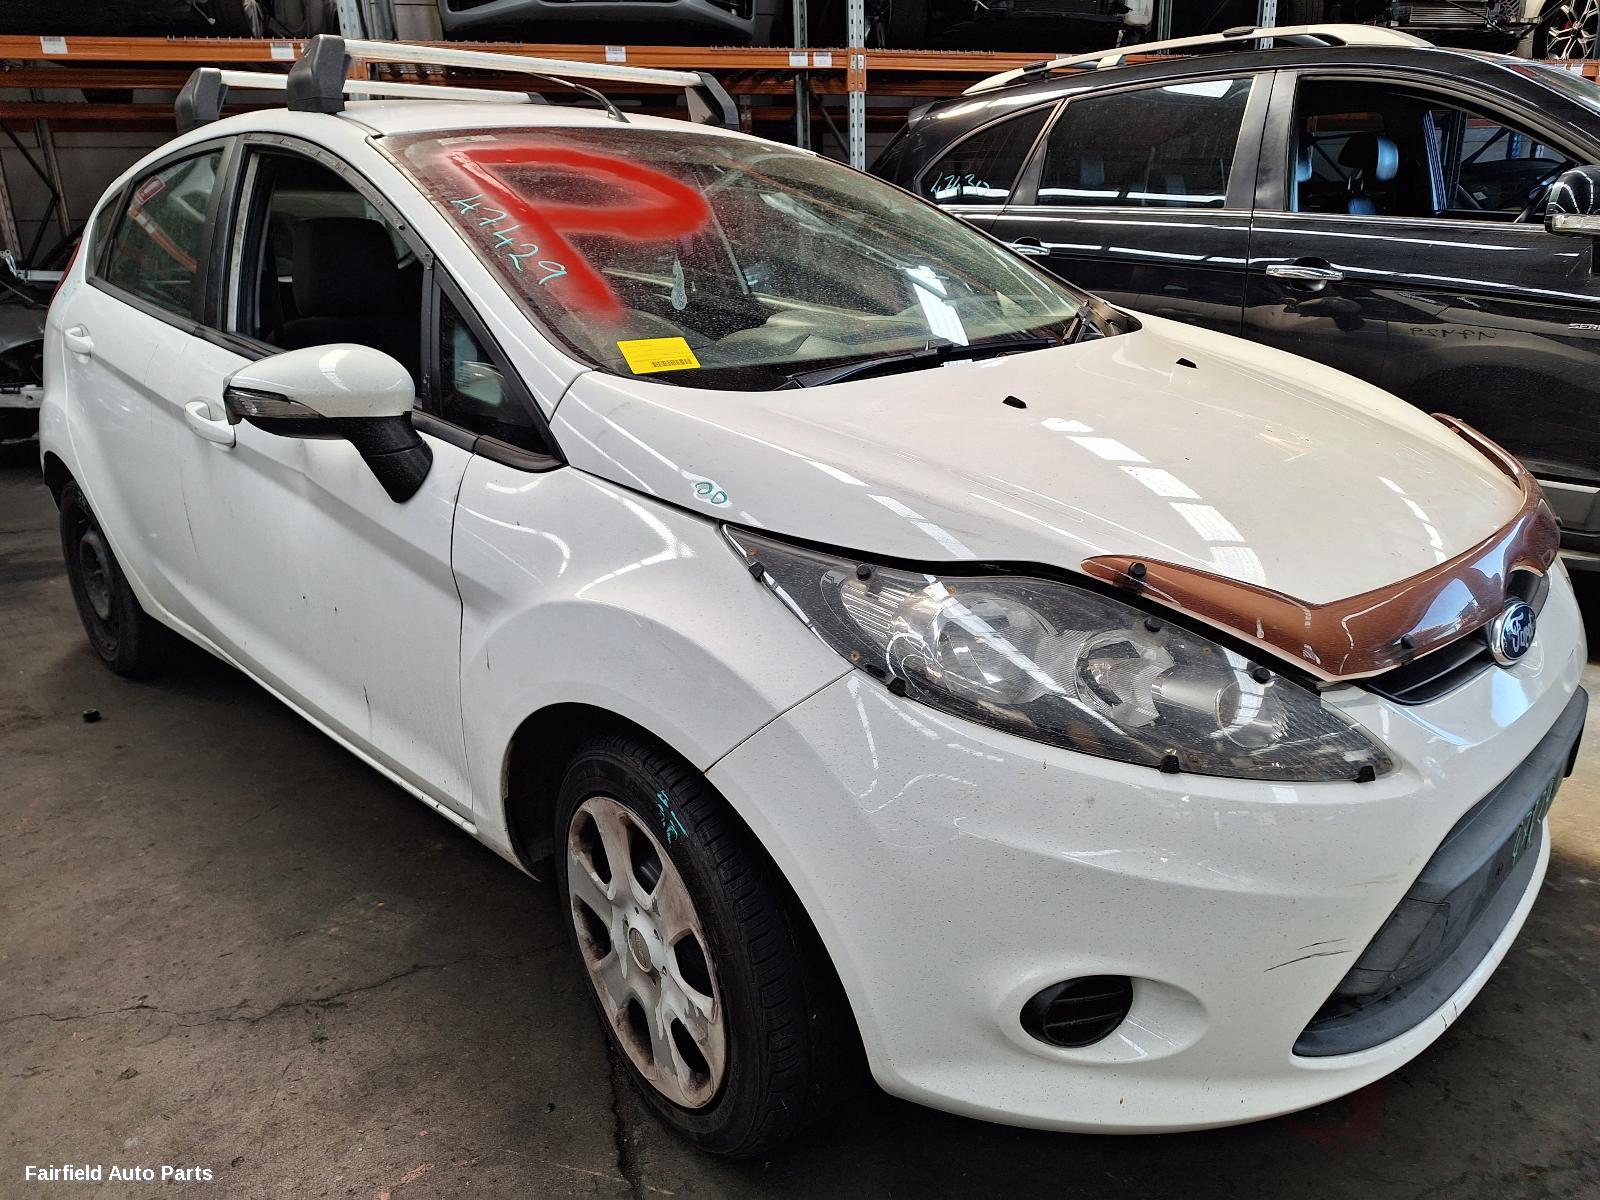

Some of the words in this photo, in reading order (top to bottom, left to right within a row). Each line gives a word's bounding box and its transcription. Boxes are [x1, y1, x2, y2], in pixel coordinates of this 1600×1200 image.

[447, 146, 711, 324] P
[450, 193, 568, 285] 47429
[1504, 610, 1536, 653] Ford
